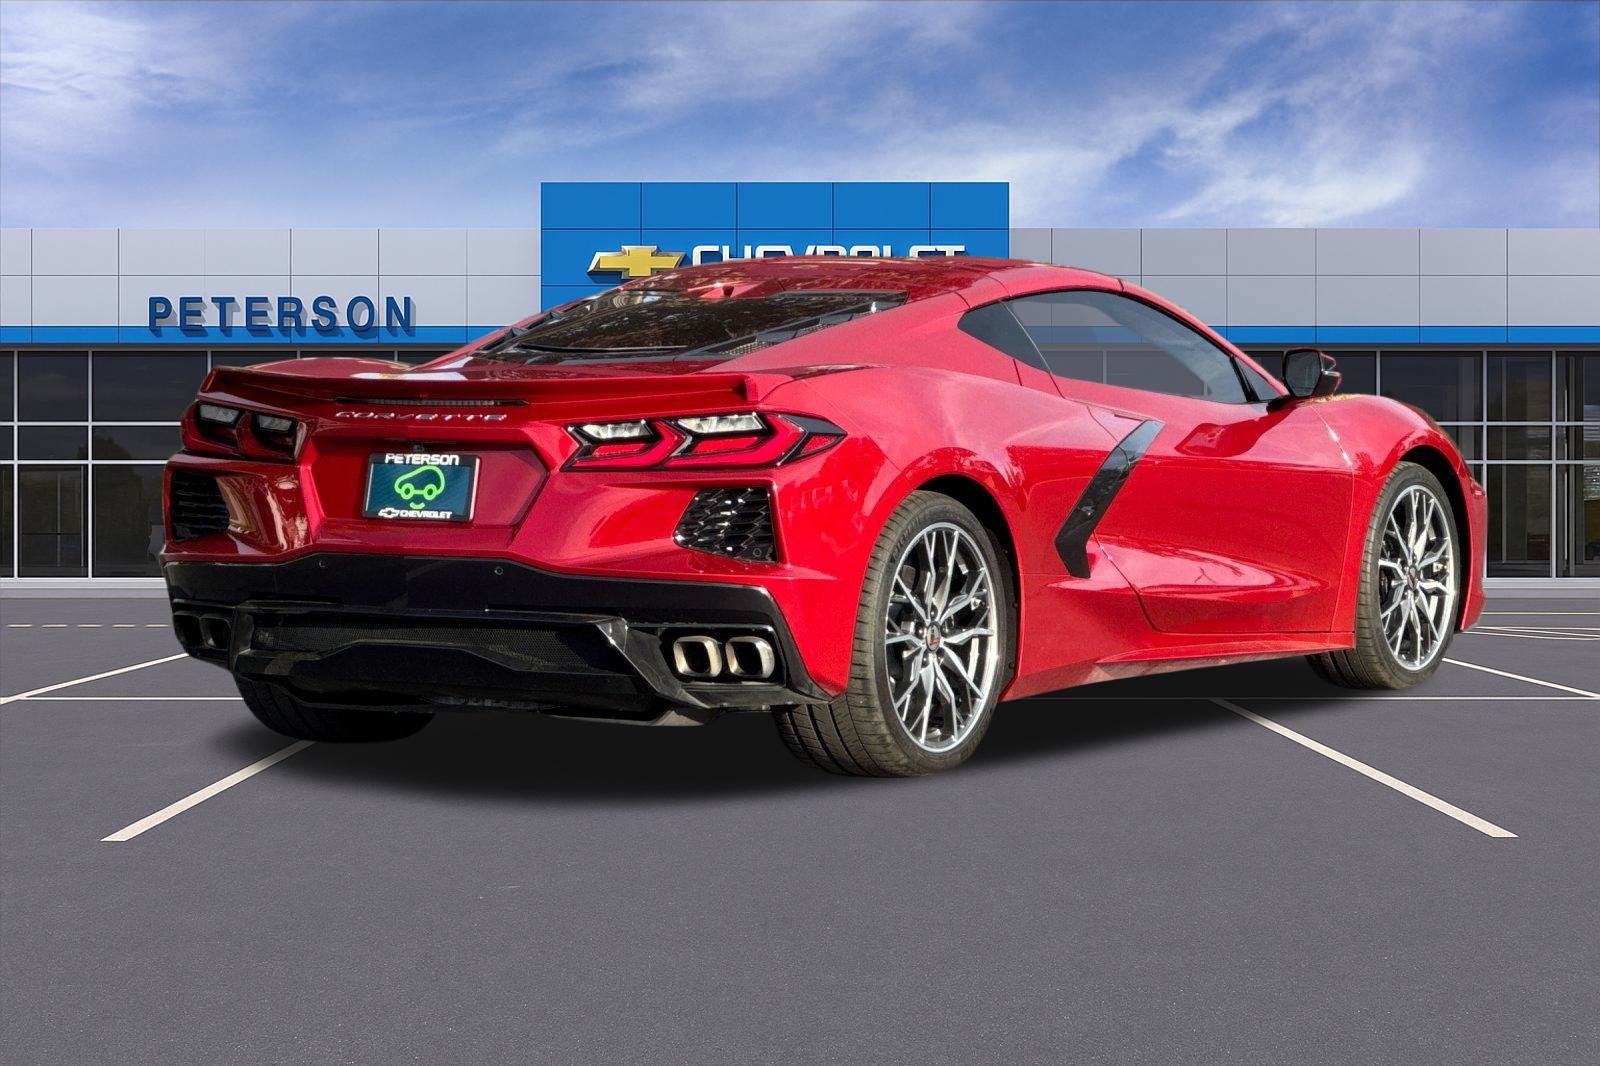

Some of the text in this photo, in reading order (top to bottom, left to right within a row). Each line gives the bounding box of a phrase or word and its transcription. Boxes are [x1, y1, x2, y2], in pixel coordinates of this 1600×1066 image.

[148, 295, 411, 332] PETERSON
[384, 453, 460, 466] PETERSON
[399, 509, 453, 519] CHEVROLET
